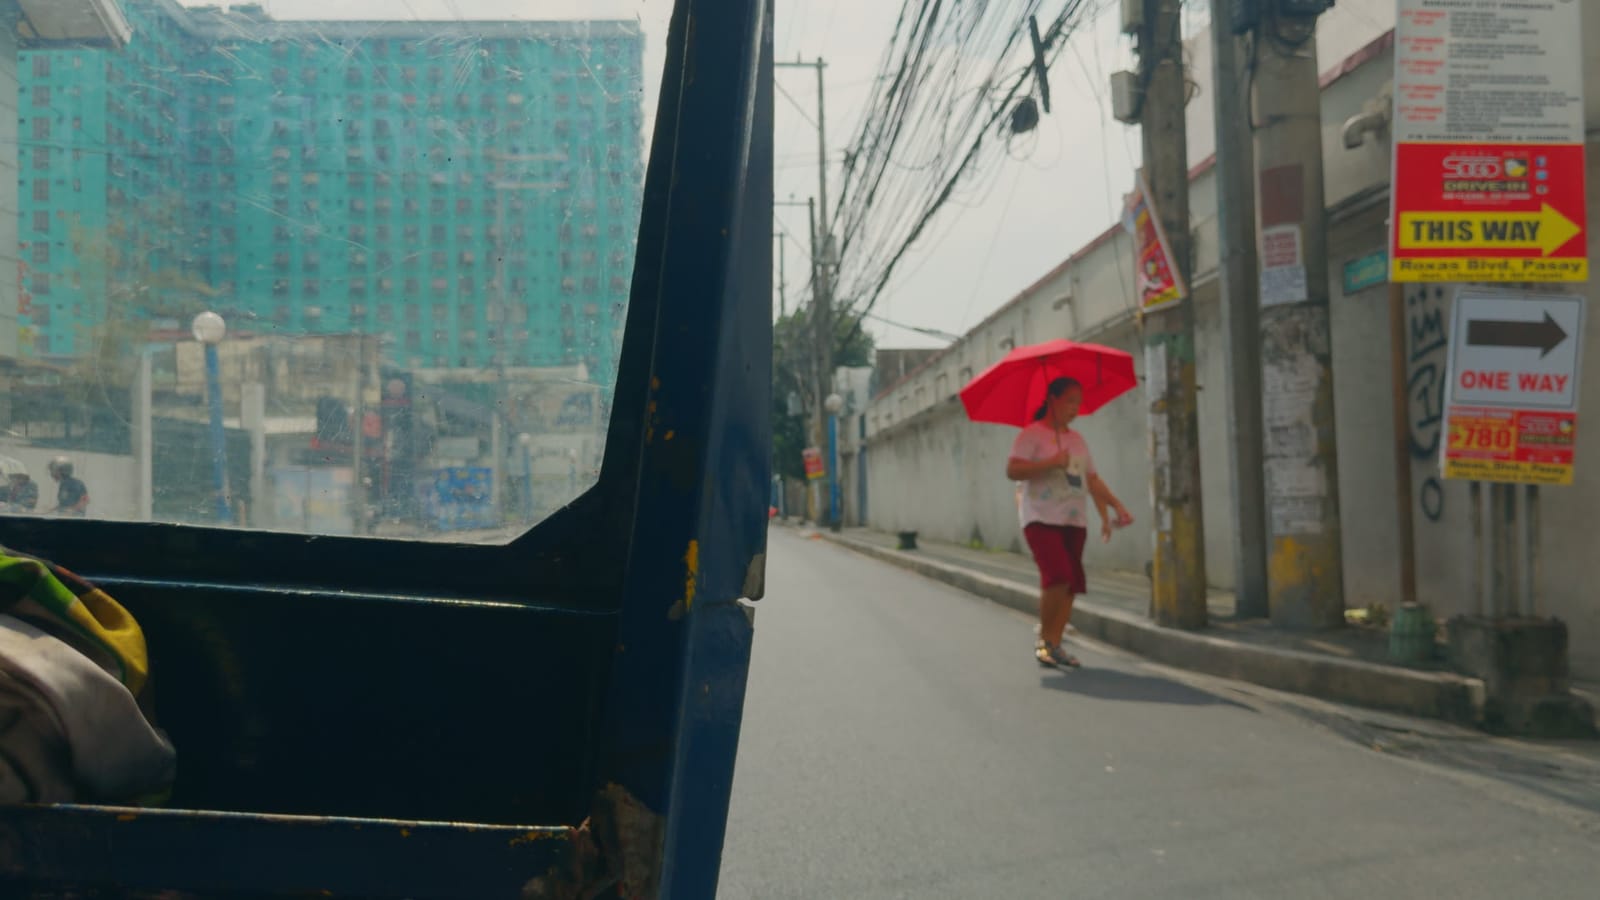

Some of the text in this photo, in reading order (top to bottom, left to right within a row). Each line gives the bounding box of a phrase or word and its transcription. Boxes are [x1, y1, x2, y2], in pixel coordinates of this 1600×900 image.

[1442, 181, 1528, 192] DRIVE-IN
[1411, 220, 1540, 242] THIS WAY
[1400, 259, 1459, 271] Roxas
[1523, 260, 1581, 273] Pasay
[1460, 370, 1568, 393] ONE WAY
